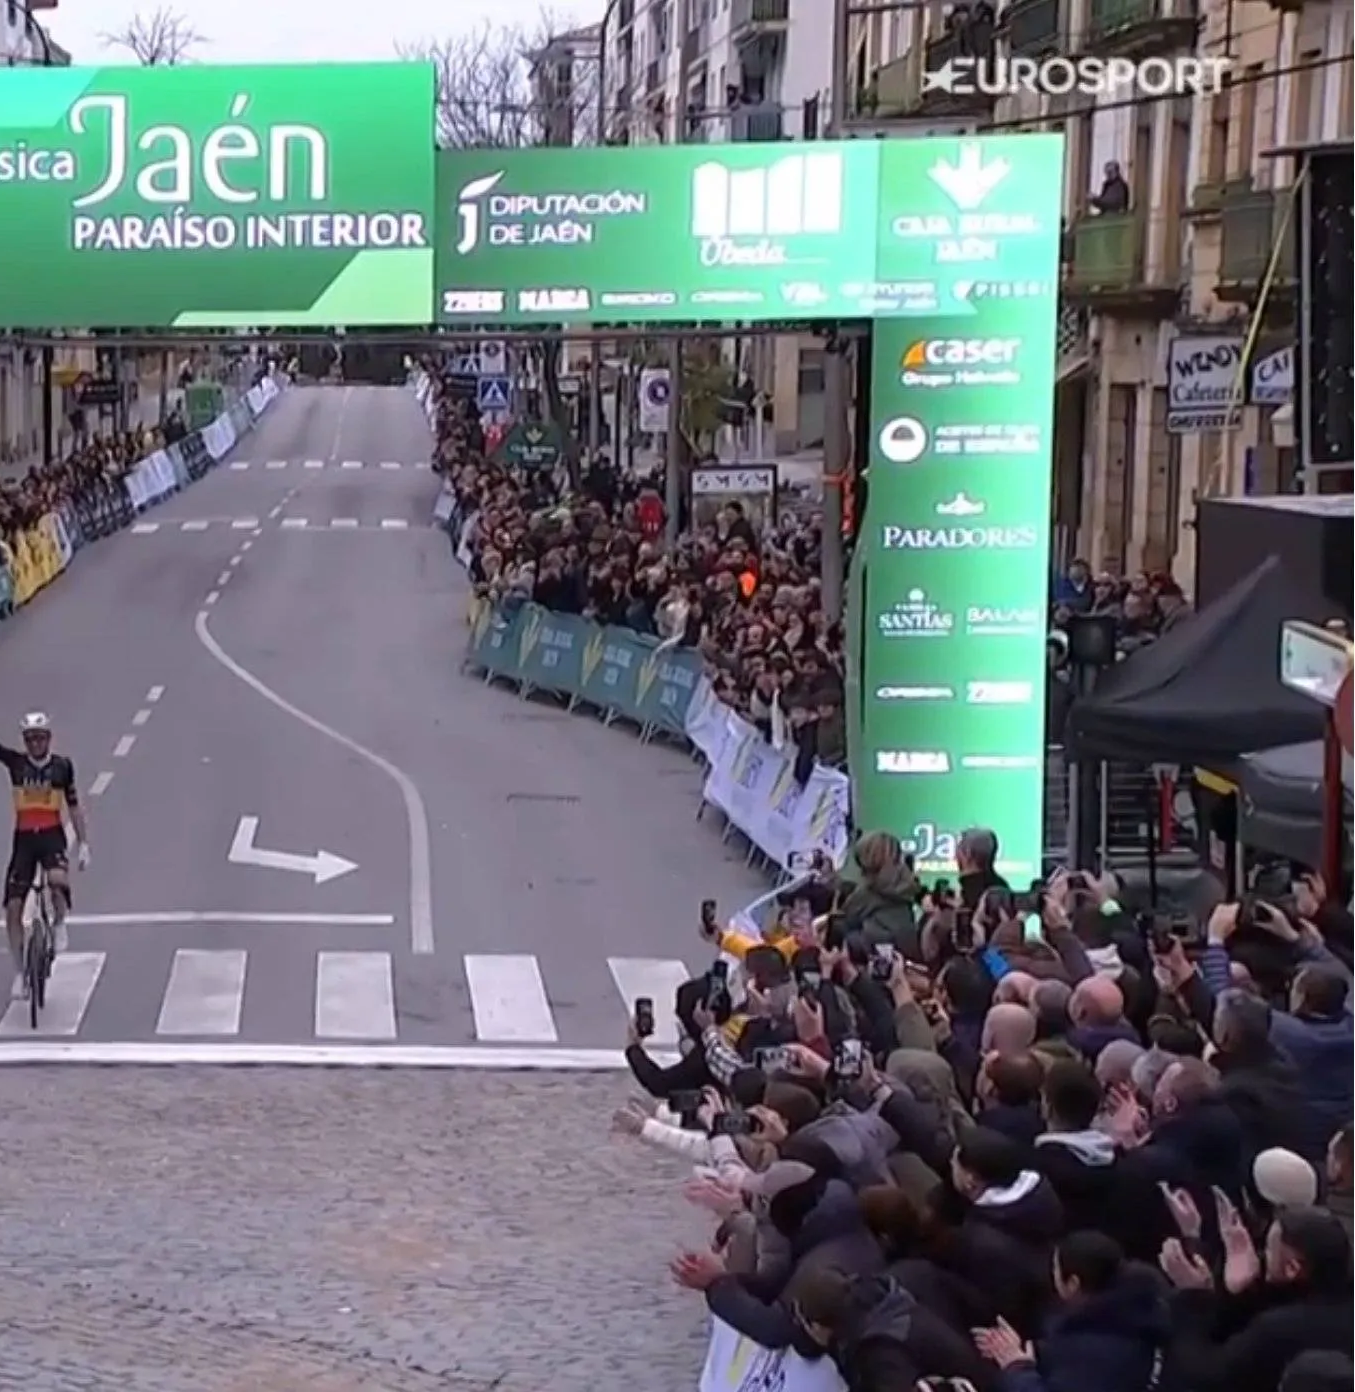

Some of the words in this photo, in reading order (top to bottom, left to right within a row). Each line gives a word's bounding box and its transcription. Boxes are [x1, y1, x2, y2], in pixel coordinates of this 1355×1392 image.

[69, 94, 326, 208] Jaén
[491, 190, 645, 216] DIPUTACIÓN
[73, 207, 236, 249] PARAÍSO
[247, 213, 425, 248] INTERIOR
[491, 223, 527, 245] DE
[528, 216, 592, 244] JAÉN
[925, 339, 1021, 364] caser
[884, 527, 1037, 548] PARADORES
